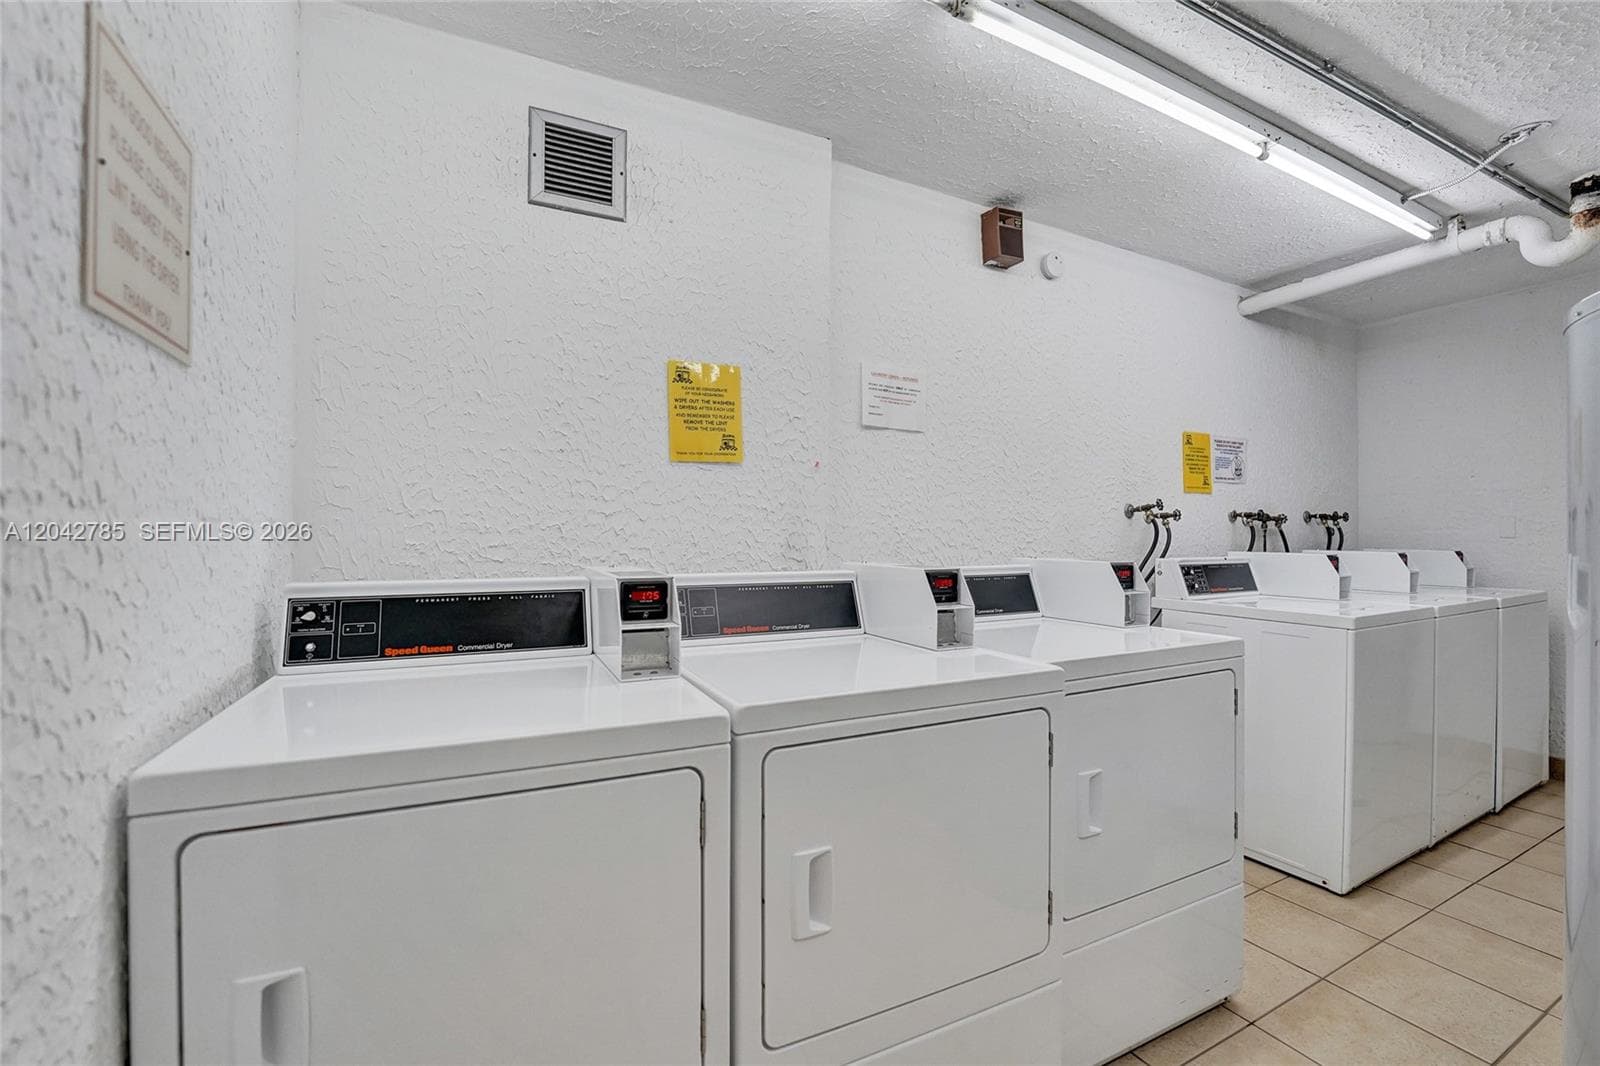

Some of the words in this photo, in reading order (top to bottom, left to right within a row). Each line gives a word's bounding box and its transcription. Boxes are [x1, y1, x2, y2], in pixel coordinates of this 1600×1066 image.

[122, 281, 153, 321] THANK
[155, 304, 172, 333] YOU
[723, 626, 746, 635] Speed
[798, 623, 810, 631] Dryer
[384, 646, 419, 656] Speed
[420, 645, 454, 654] Queen
[457, 643, 495, 651] Commercial
[496, 642, 513, 650] Dryer
